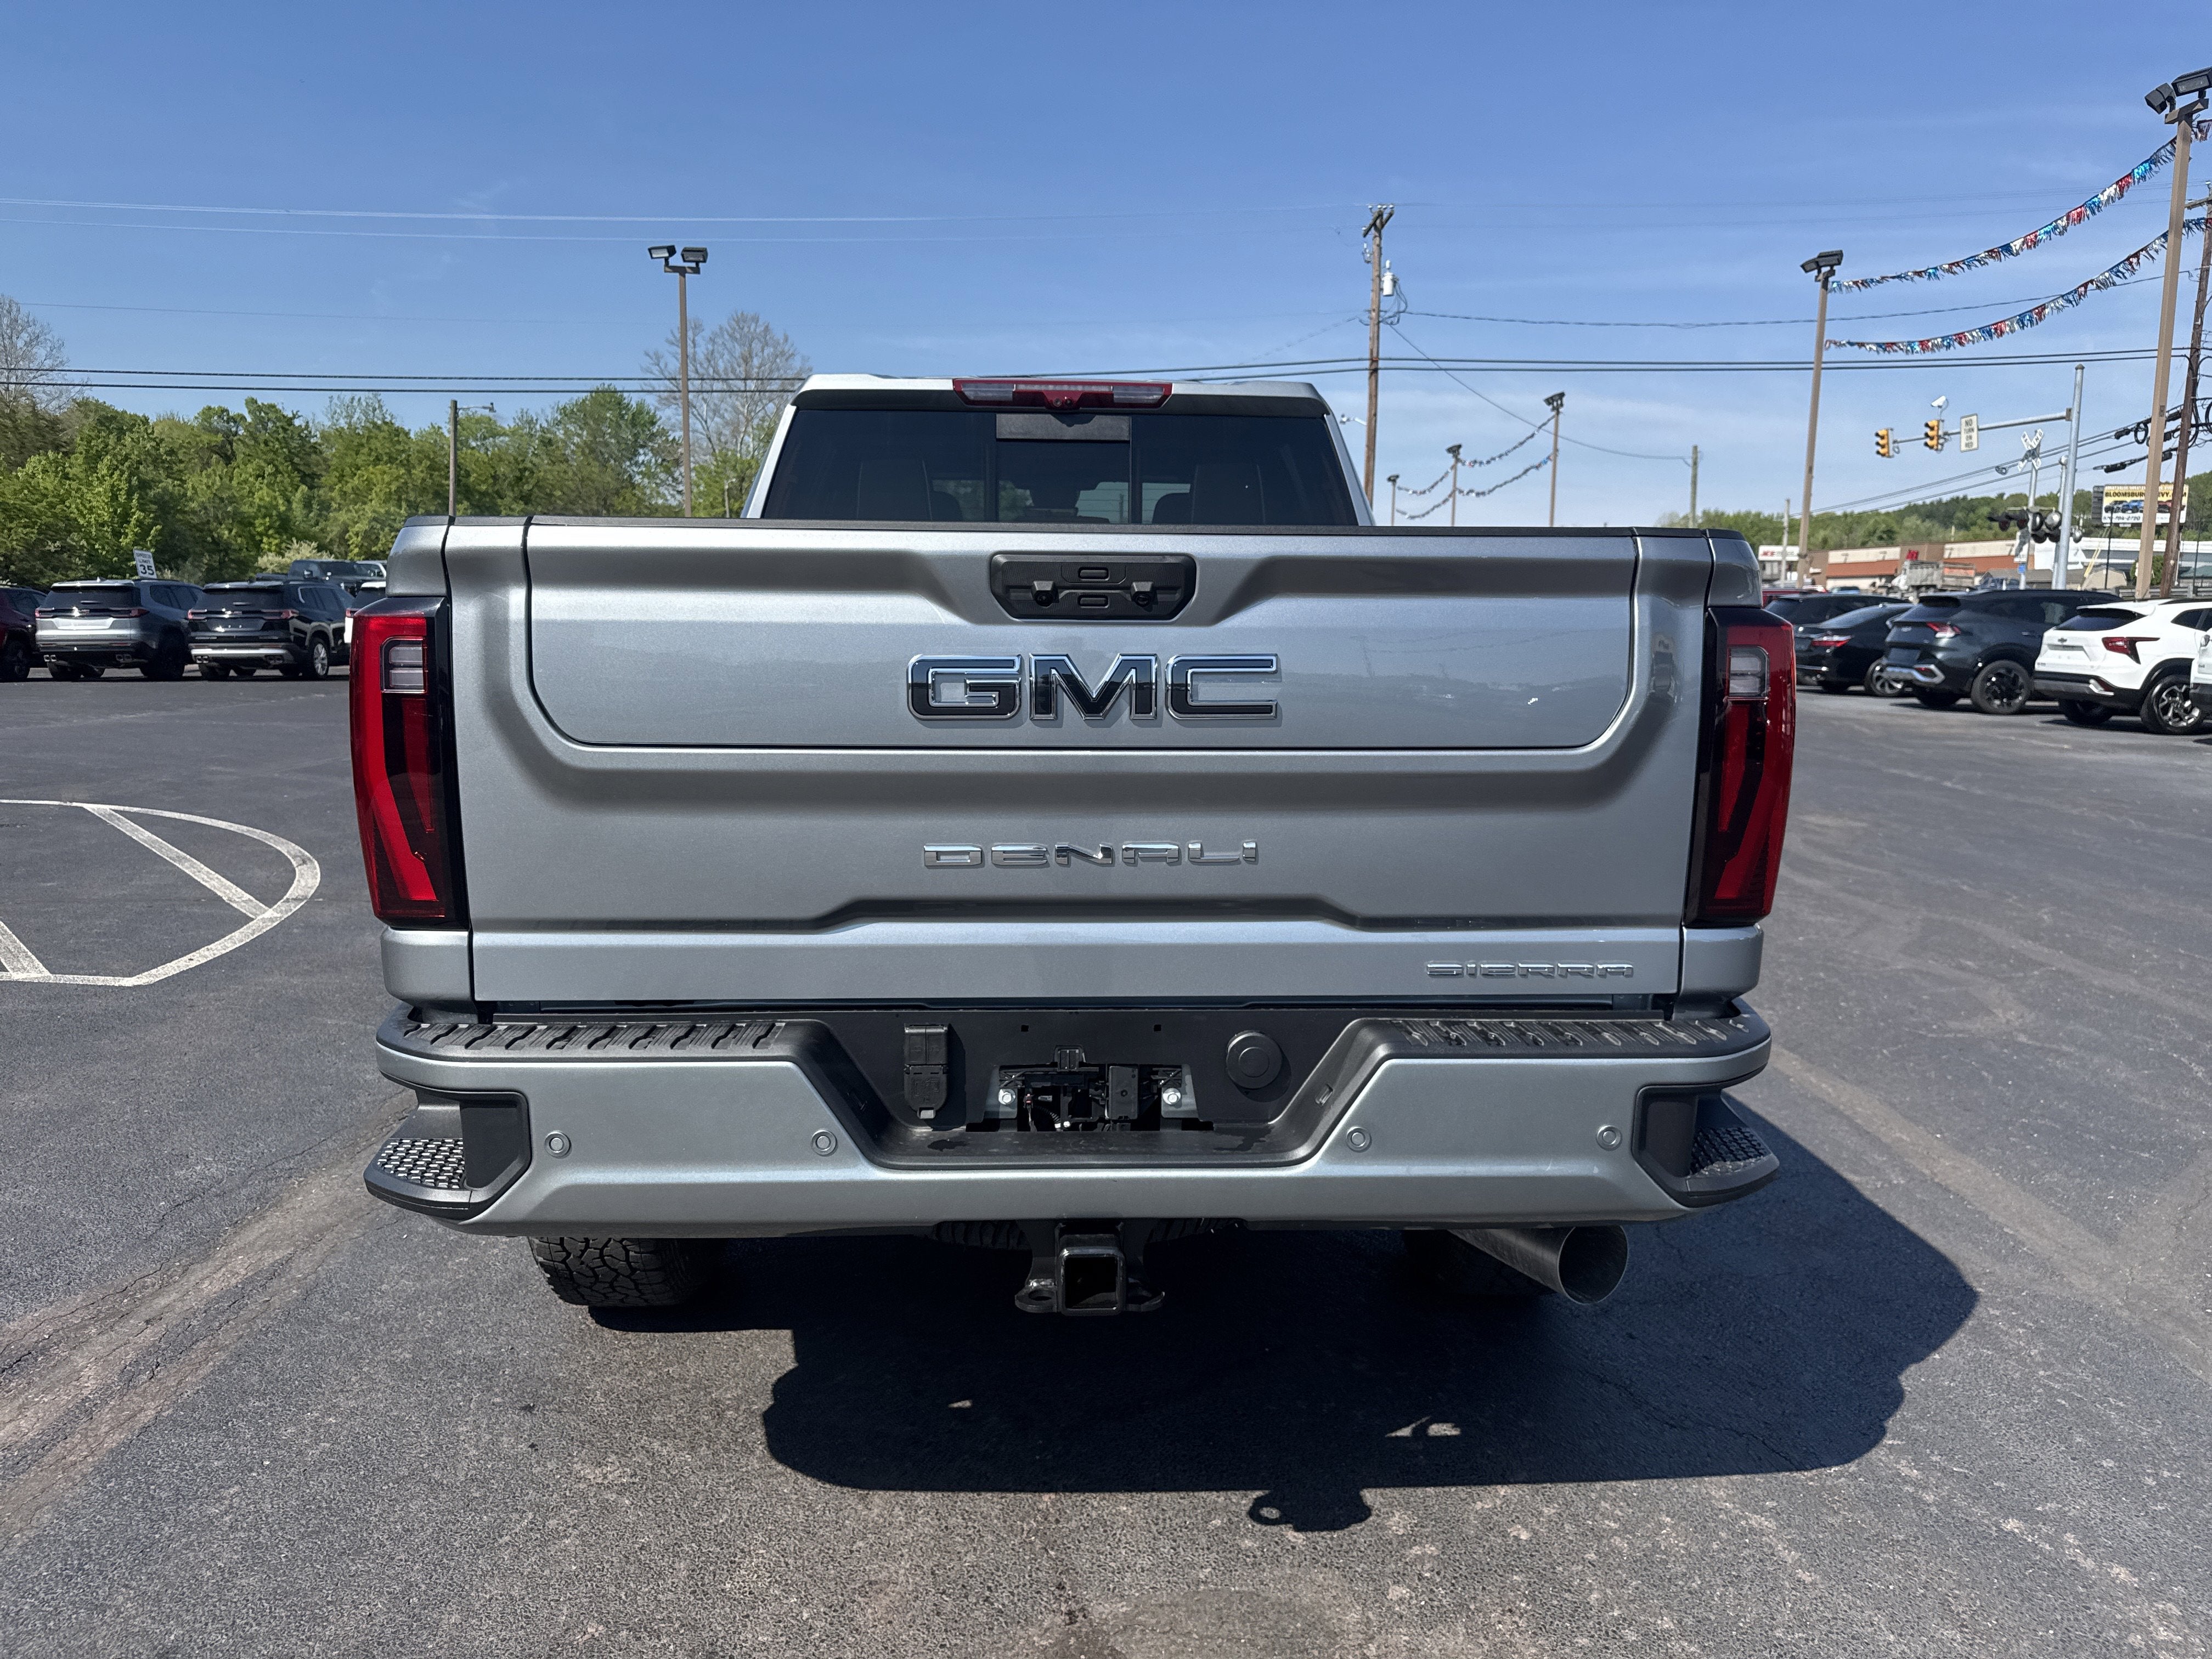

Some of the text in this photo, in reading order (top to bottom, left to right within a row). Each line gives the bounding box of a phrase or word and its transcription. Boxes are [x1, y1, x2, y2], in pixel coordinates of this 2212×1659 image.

[1965, 419, 1972, 427] NO
[139, 565, 154, 575] 35
[906, 653, 1278, 720] GMC
[924, 840, 1257, 867] DENALI
[1427, 963, 1634, 977] SIERRA
